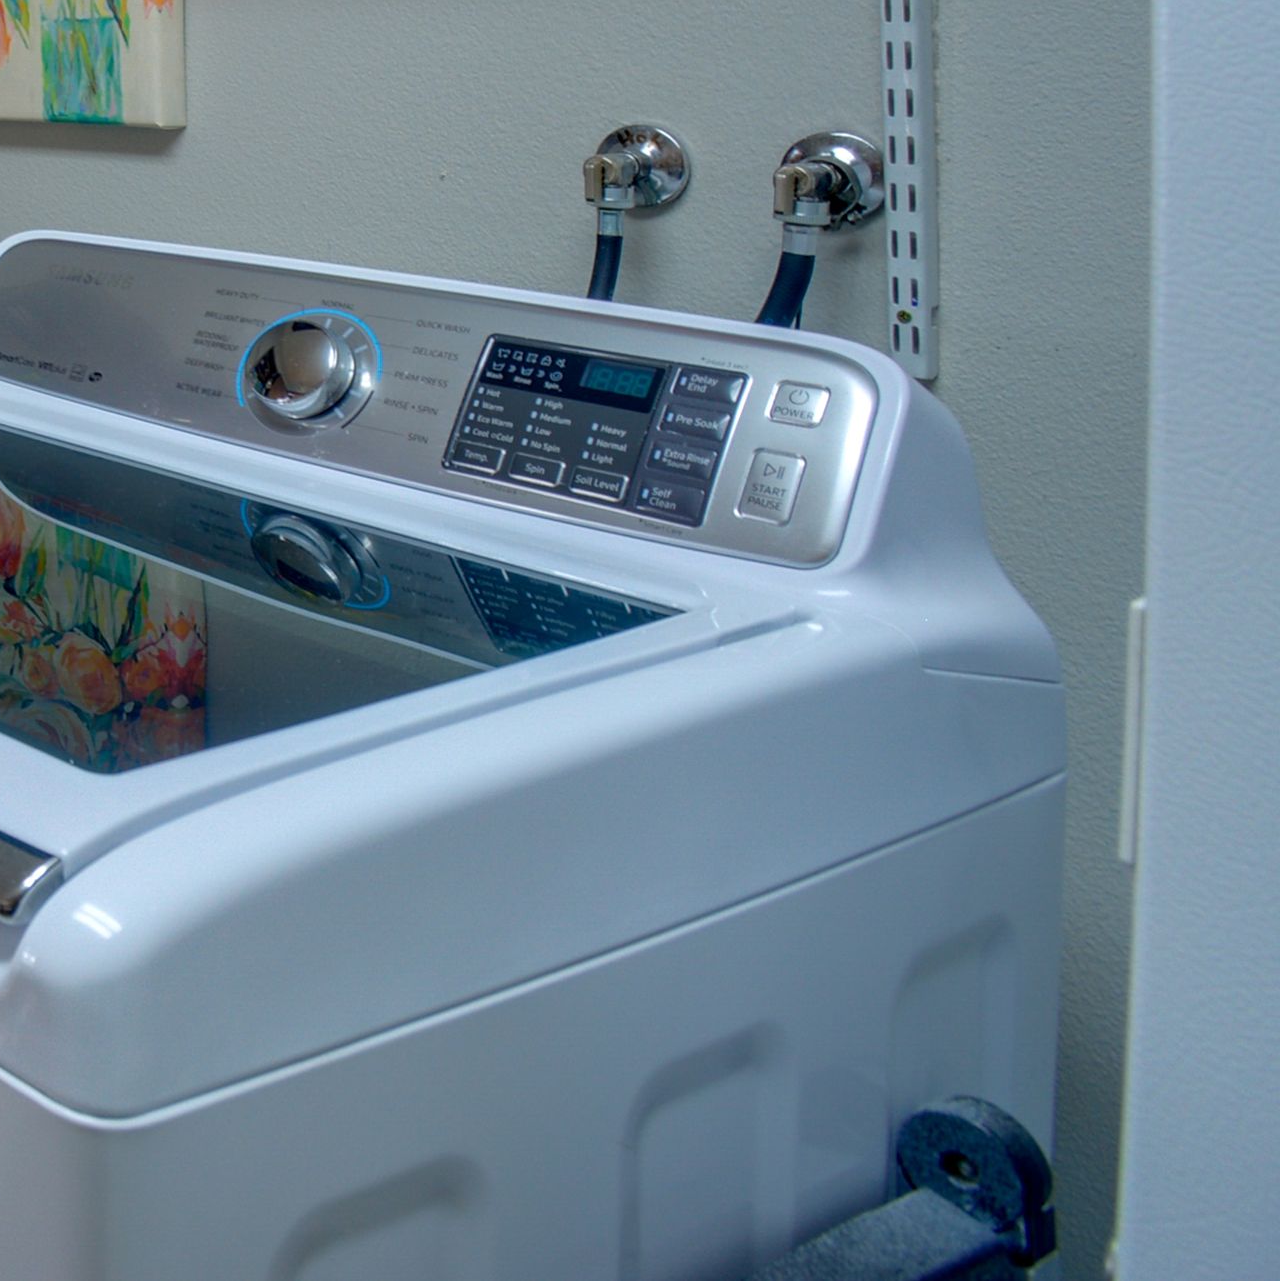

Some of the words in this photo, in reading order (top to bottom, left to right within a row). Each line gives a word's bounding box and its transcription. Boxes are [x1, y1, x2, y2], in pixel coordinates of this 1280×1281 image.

[416, 319, 442, 329] QUICK
[444, 324, 471, 334] WASH
[413, 346, 459, 361] DELICATES
[486, 371, 504, 380] Wash
[513, 375, 532, 385] Rinse
[690, 374, 719, 387] Delay
[422, 377, 448, 389] PRESS
[544, 381, 559, 391] Spin
[687, 383, 707, 394] End
[486, 388, 501, 398] Hot
[417, 405, 439, 416] SPIN
[482, 401, 504, 412] Warm
[544, 399, 563, 411] High
[540, 413, 572, 426] Medium
[774, 406, 814, 420] POWER
[477, 414, 490, 425] Eco
[491, 417, 514, 429] Warm
[675, 413, 694, 425] Pre
[695, 416, 719, 430] Soak
[472, 427, 489, 438] Cool
[534, 427, 552, 437] Low
[600, 425, 627, 438] Heavy
[408, 433, 429, 445] SPIN
[531, 440, 542, 449] No
[543, 442, 561, 454] Spin
[596, 439, 628, 453] Normal
[464, 449, 488, 462] Temp.
[592, 453, 614, 466] Light
[664, 448, 686, 461] Extra
[687, 452, 710, 466] Rinse
[525, 462, 545, 476] Spin
[575, 474, 593, 487] Soil
[594, 478, 620, 493] Level
[752, 482, 787, 497] START
[651, 486, 672, 498] Self
[649, 496, 677, 510] Clean
[747, 495, 783, 512] PAUSE
